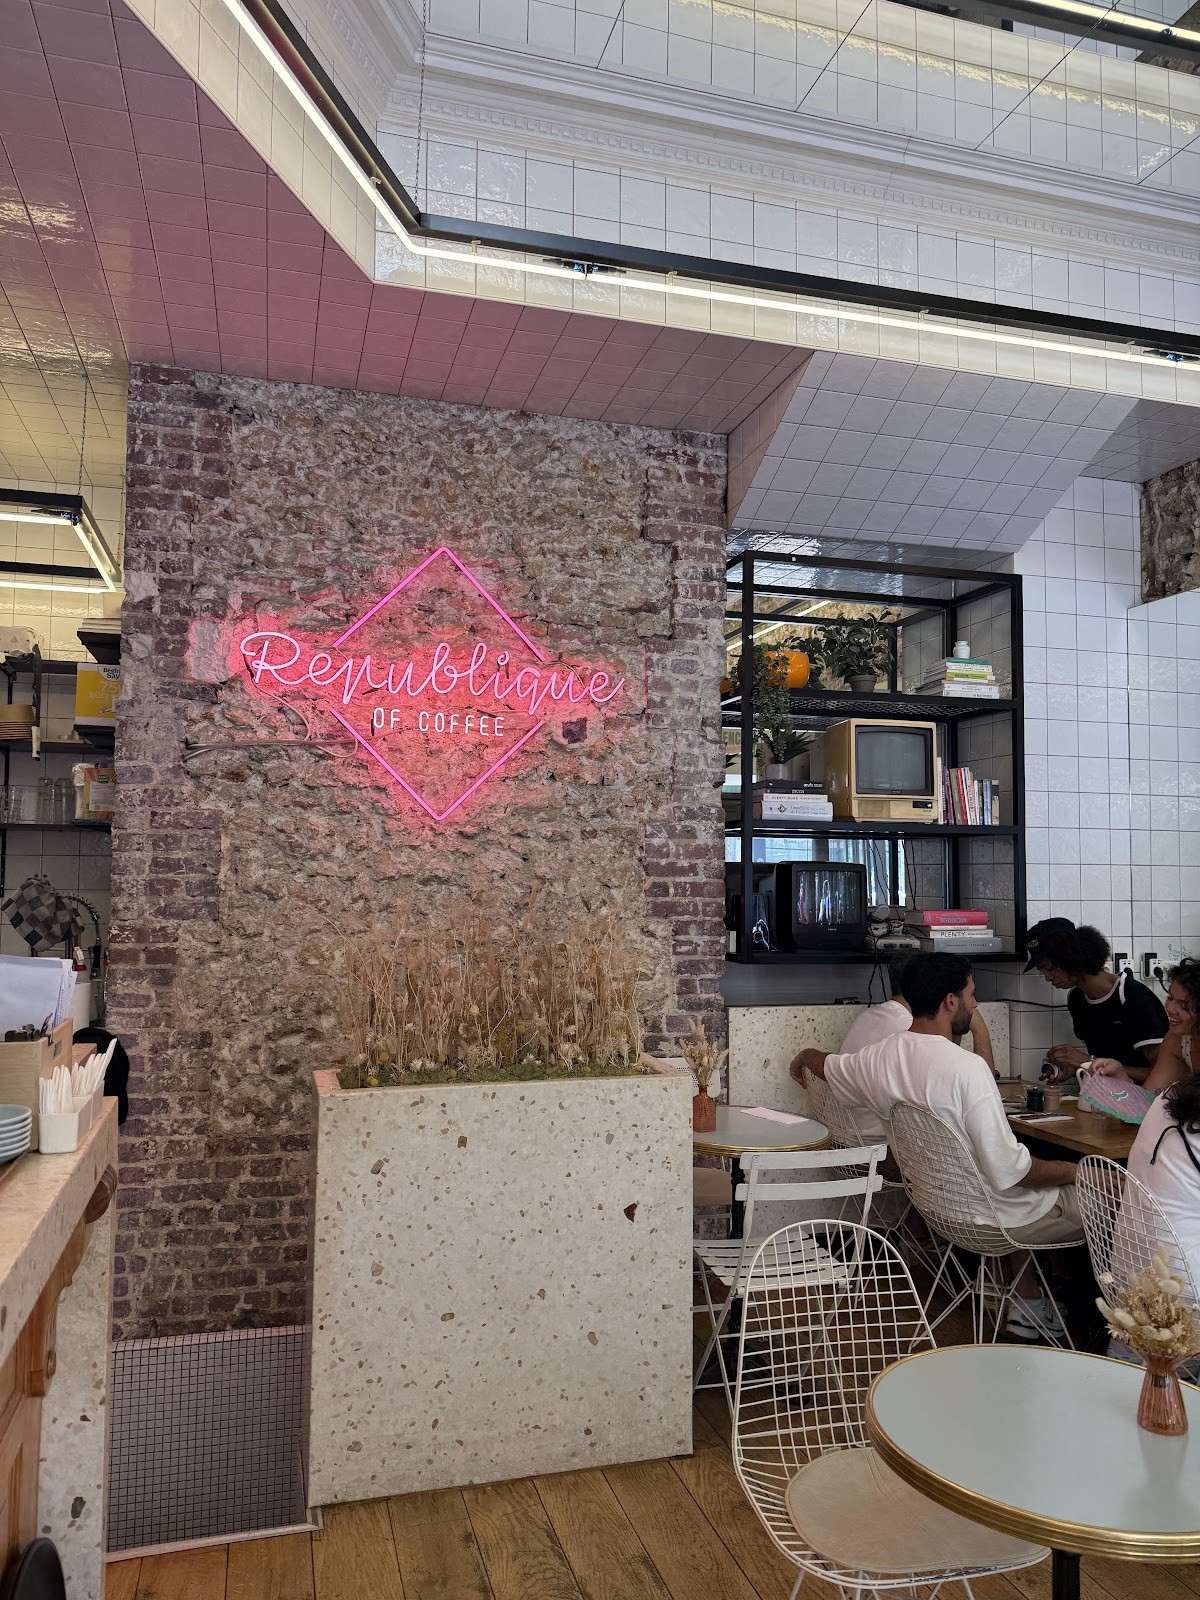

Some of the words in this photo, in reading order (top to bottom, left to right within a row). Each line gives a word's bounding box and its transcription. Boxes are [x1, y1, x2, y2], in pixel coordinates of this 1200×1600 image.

[240, 631, 625, 714] Republique
[373, 707, 401, 729] OF
[418, 710, 505, 737] COFFEE
